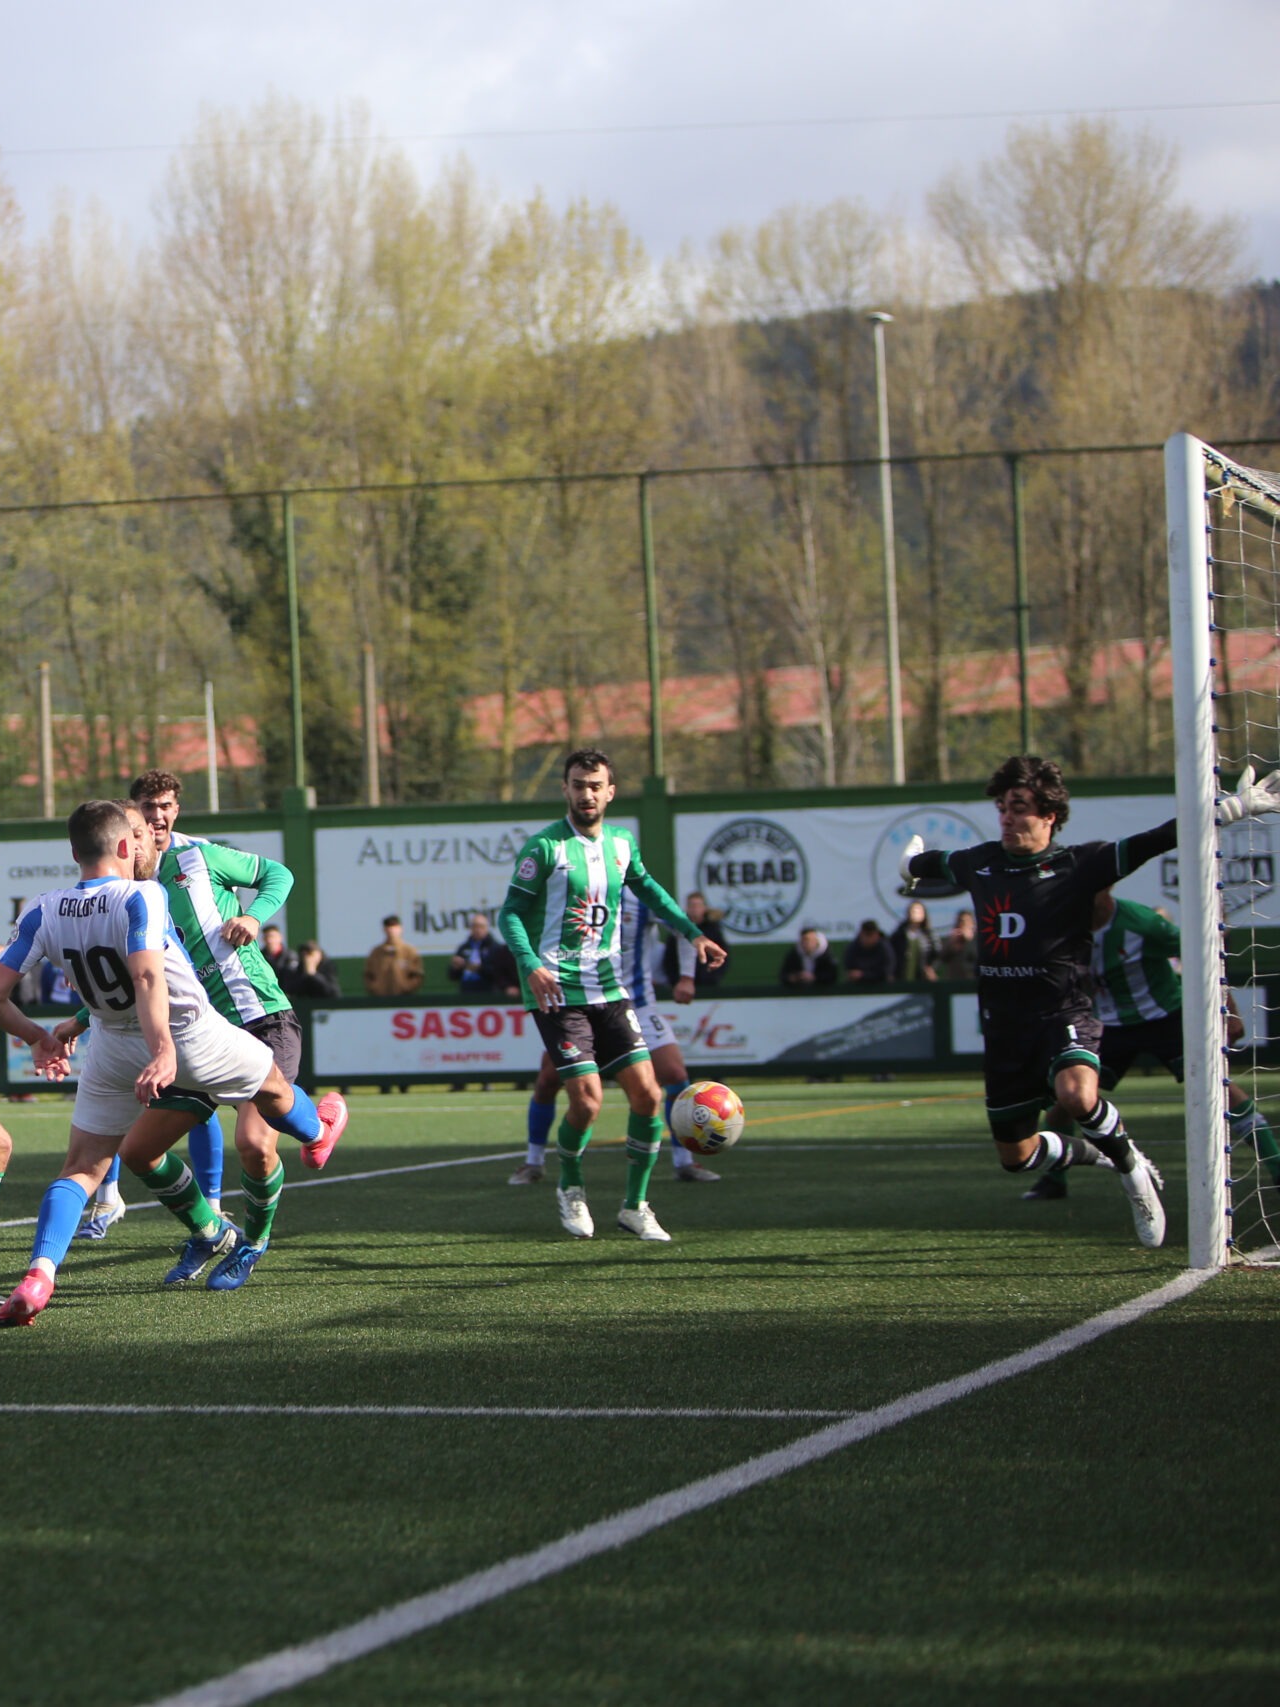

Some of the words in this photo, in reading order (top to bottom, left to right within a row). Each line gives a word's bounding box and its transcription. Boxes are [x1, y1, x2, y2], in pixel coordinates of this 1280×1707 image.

[9, 865, 59, 879] CENTRO
[707, 860, 796, 886] KEBAB
[589, 905, 609, 927] D
[998, 913, 1026, 938] D
[63, 946, 135, 1011] 19
[392, 1010, 529, 1041] SASOT
[626, 1009, 642, 1033] 8
